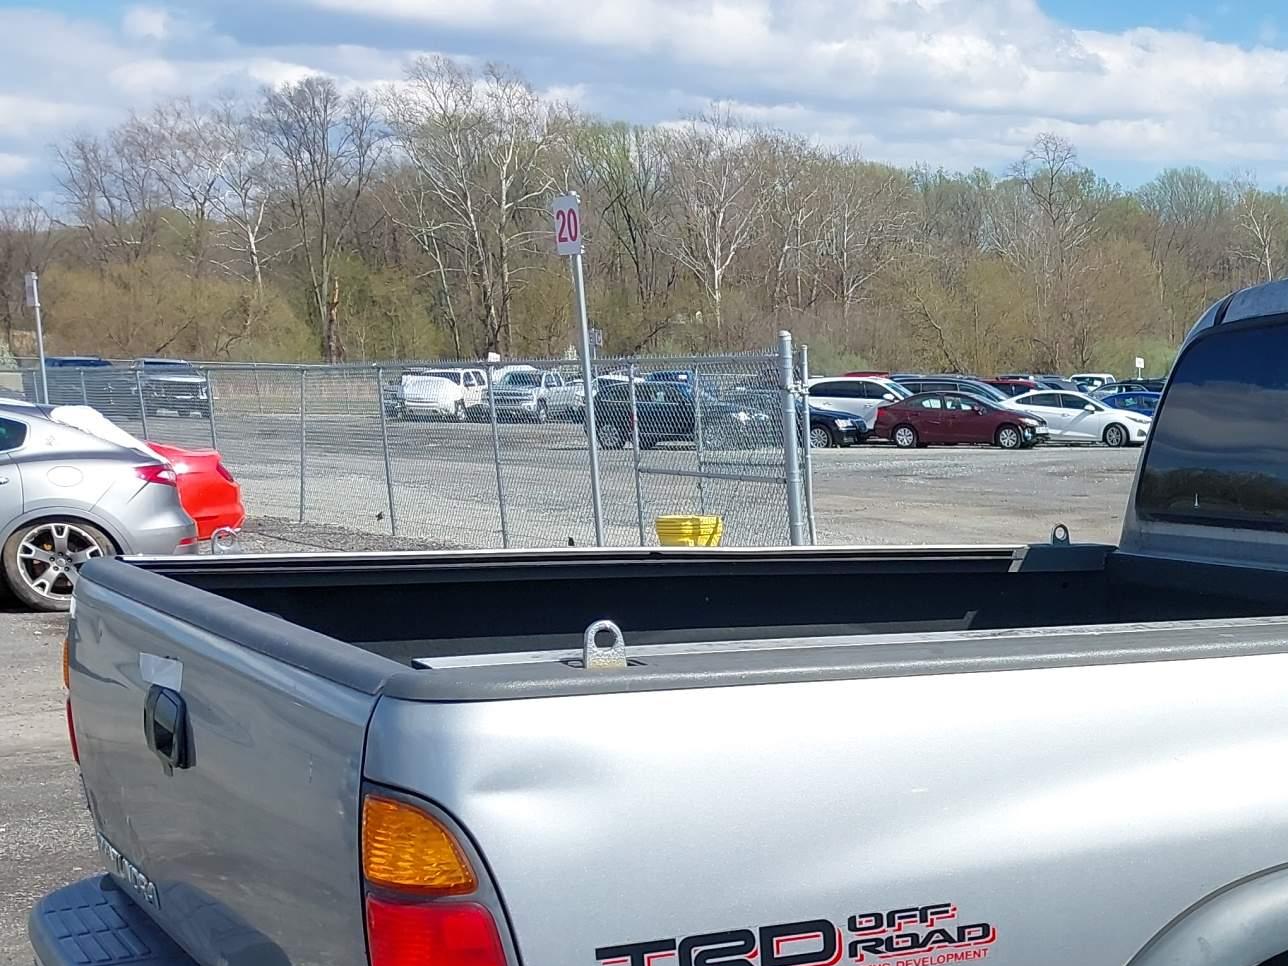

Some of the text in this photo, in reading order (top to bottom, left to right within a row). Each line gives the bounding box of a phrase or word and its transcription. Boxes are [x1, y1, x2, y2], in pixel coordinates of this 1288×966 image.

[556, 207, 578, 243] 20
[847, 902, 957, 936] OFF
[848, 922, 997, 962] ROAD
